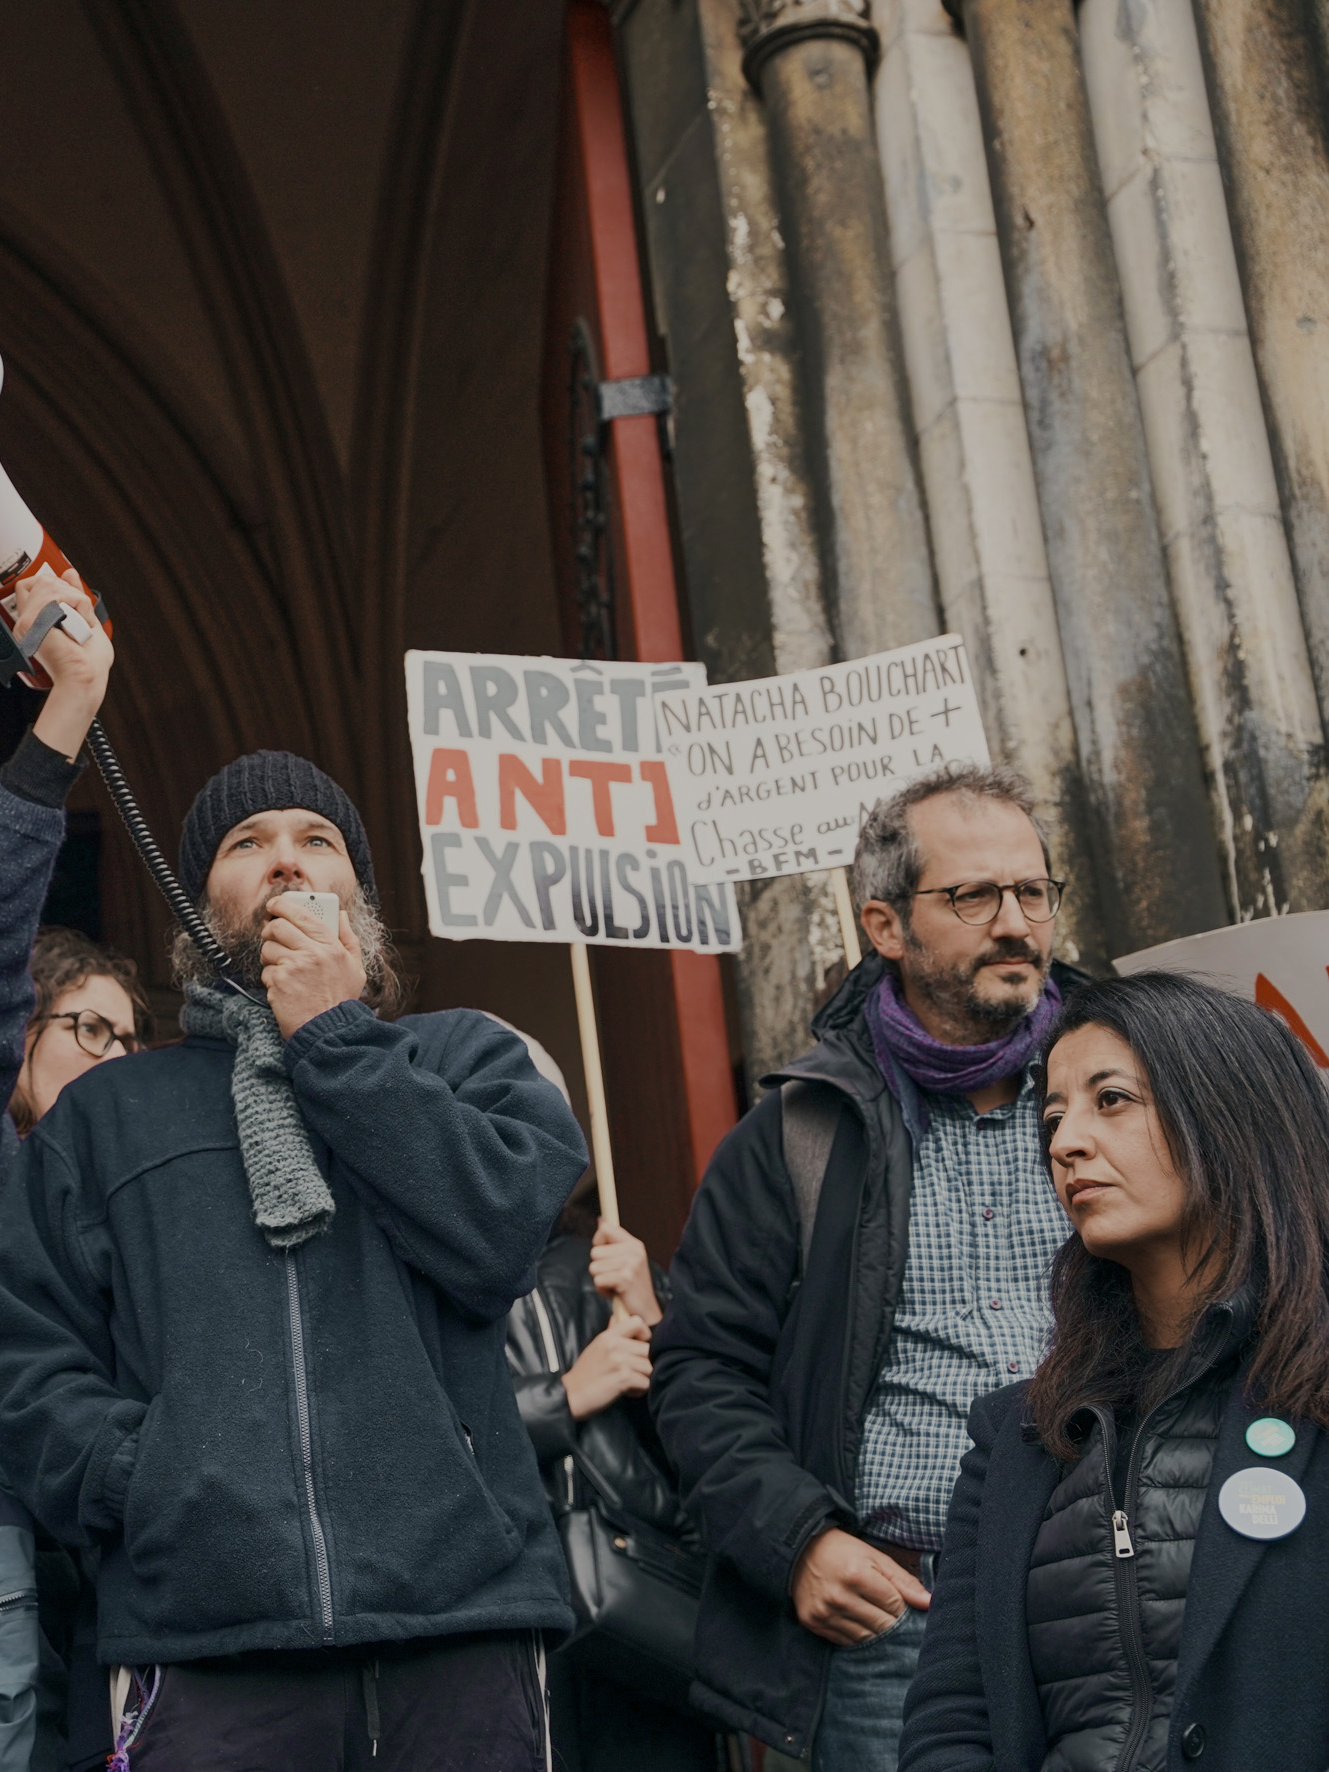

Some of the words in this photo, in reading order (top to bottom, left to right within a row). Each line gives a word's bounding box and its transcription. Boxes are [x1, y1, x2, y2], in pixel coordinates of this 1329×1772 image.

[661, 682, 809, 736] NATACHA
[820, 644, 967, 714] BOUCHART
[889, 707, 924, 740] DE
[930, 697, 963, 728] +
[831, 755, 896, 786] POUR
[913, 743, 945, 767] LA
[425, 747, 681, 845] ANTI
[691, 819, 804, 867] Chasse
[1239, 1504, 1277, 1515] KARIMA
[1251, 1514, 1279, 1525] DELLI
